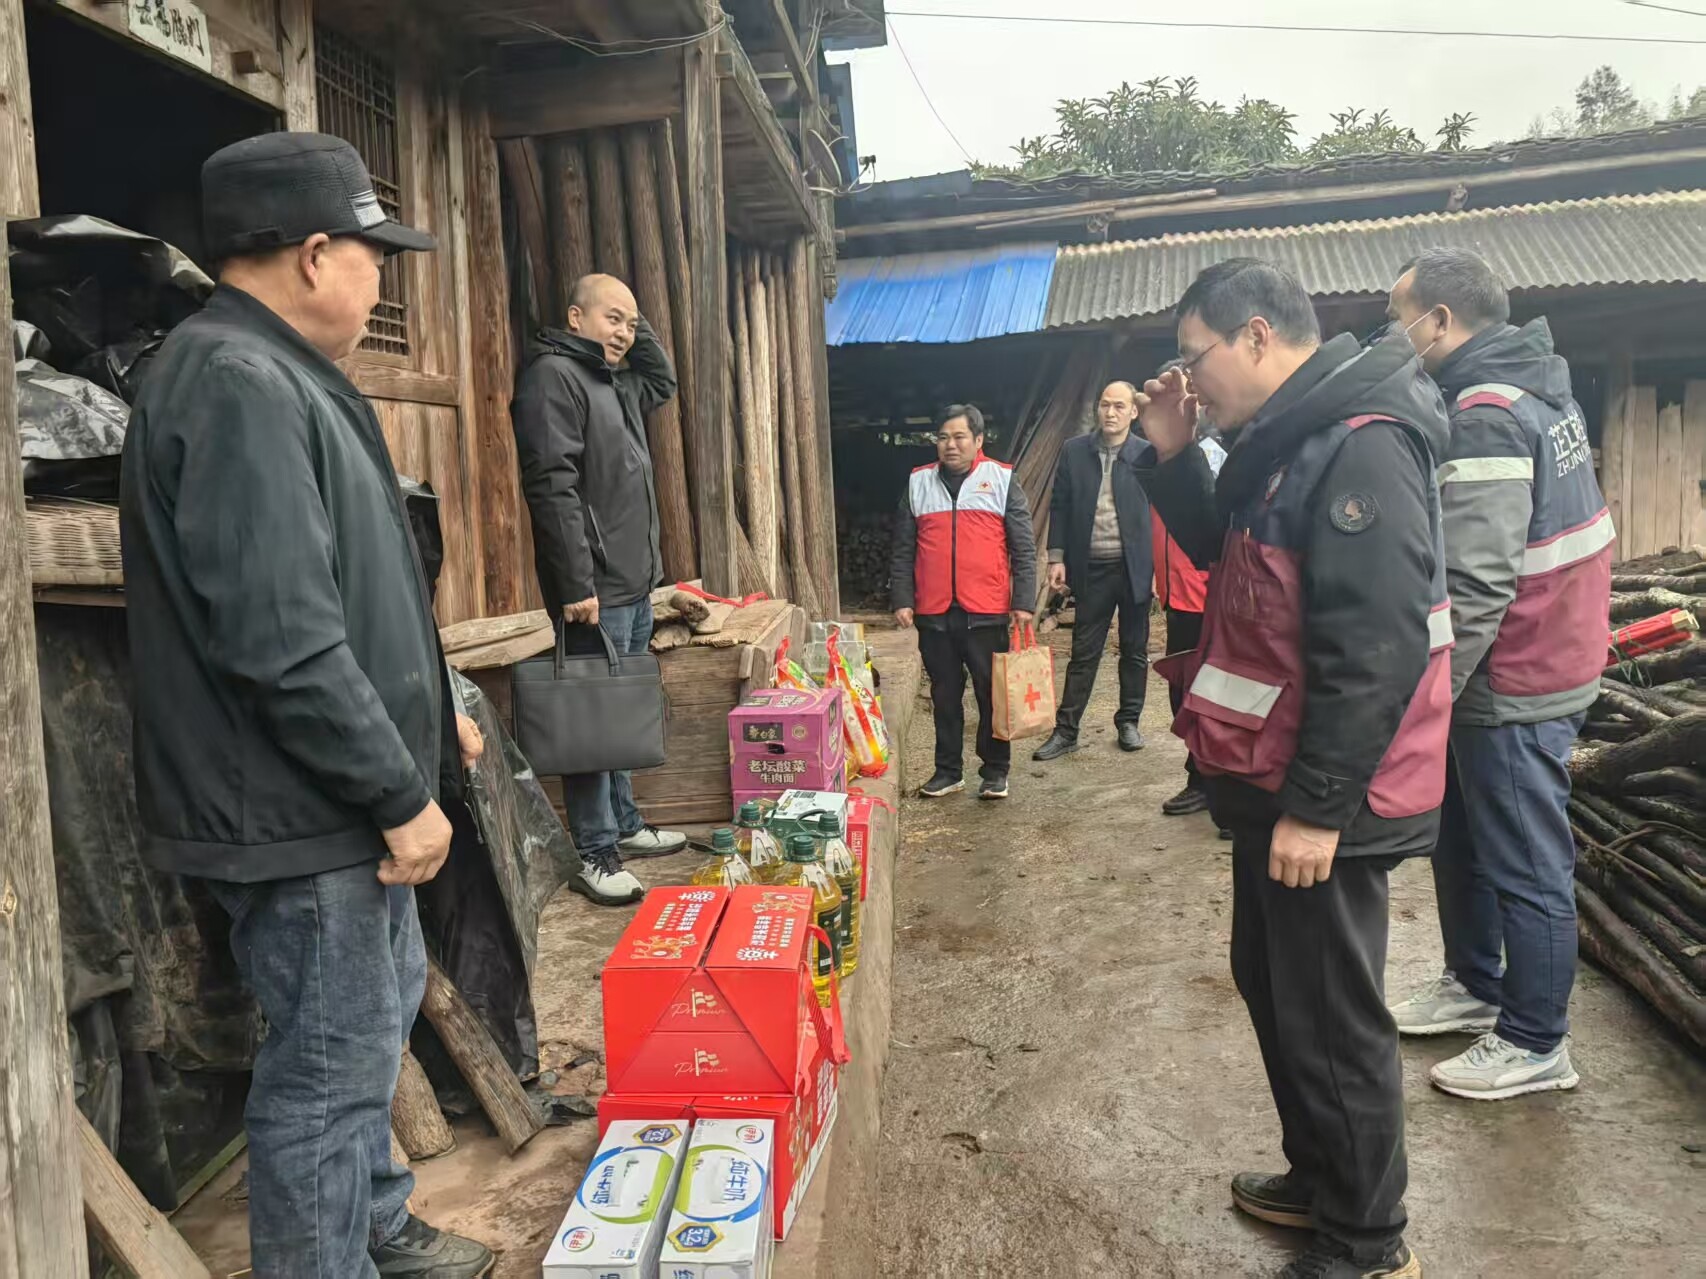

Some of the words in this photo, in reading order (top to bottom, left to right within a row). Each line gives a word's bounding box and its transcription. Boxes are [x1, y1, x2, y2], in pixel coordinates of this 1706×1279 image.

[748, 760, 806, 773] 老坛酸菜
[760, 773, 794, 784] 牛肉面
[671, 1003, 727, 1018] Prmium
[674, 1062, 729, 1077] Prmium
[743, 1127, 757, 1141] 伊利
[724, 1159, 751, 1201] 纯牛奶
[568, 1230, 586, 1249] 伊利
